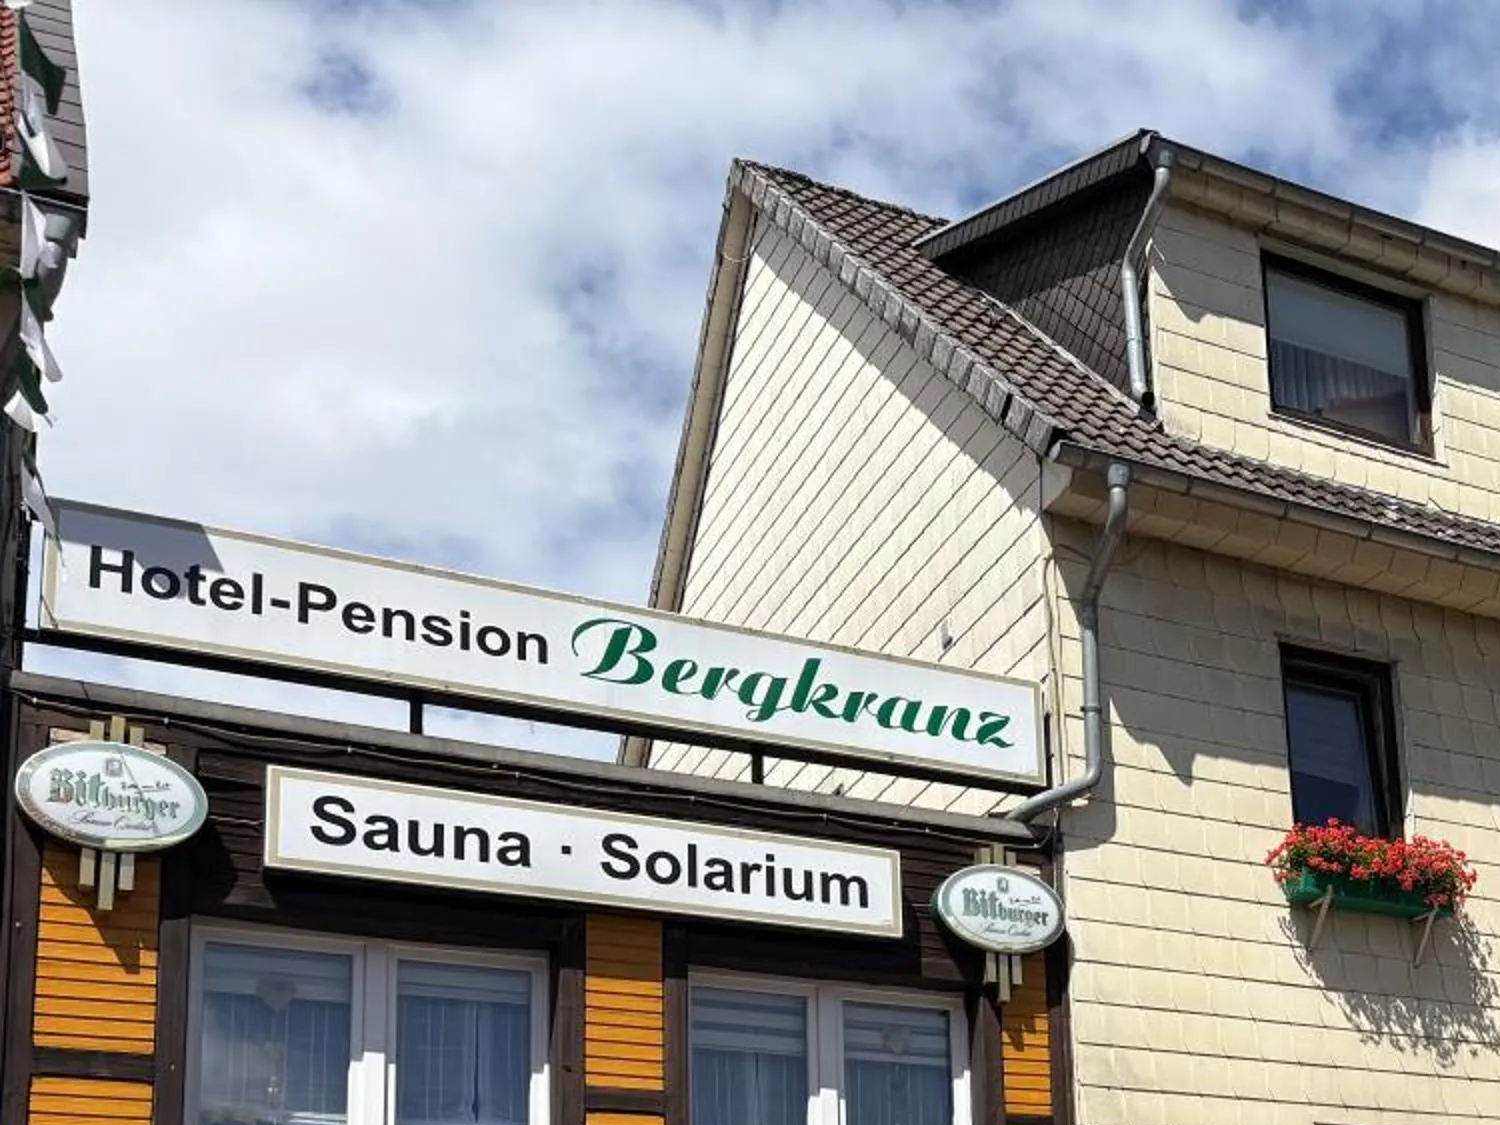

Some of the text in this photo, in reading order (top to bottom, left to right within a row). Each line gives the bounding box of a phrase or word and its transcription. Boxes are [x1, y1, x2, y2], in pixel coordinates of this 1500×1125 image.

[88, 545, 1014, 749] Hotel-Pension Bergkranz
[46, 767, 181, 821] Bitburger
[310, 795, 532, 868] Sauna
[599, 833, 870, 909] Solarium
[961, 887, 1049, 927] Bitburger
